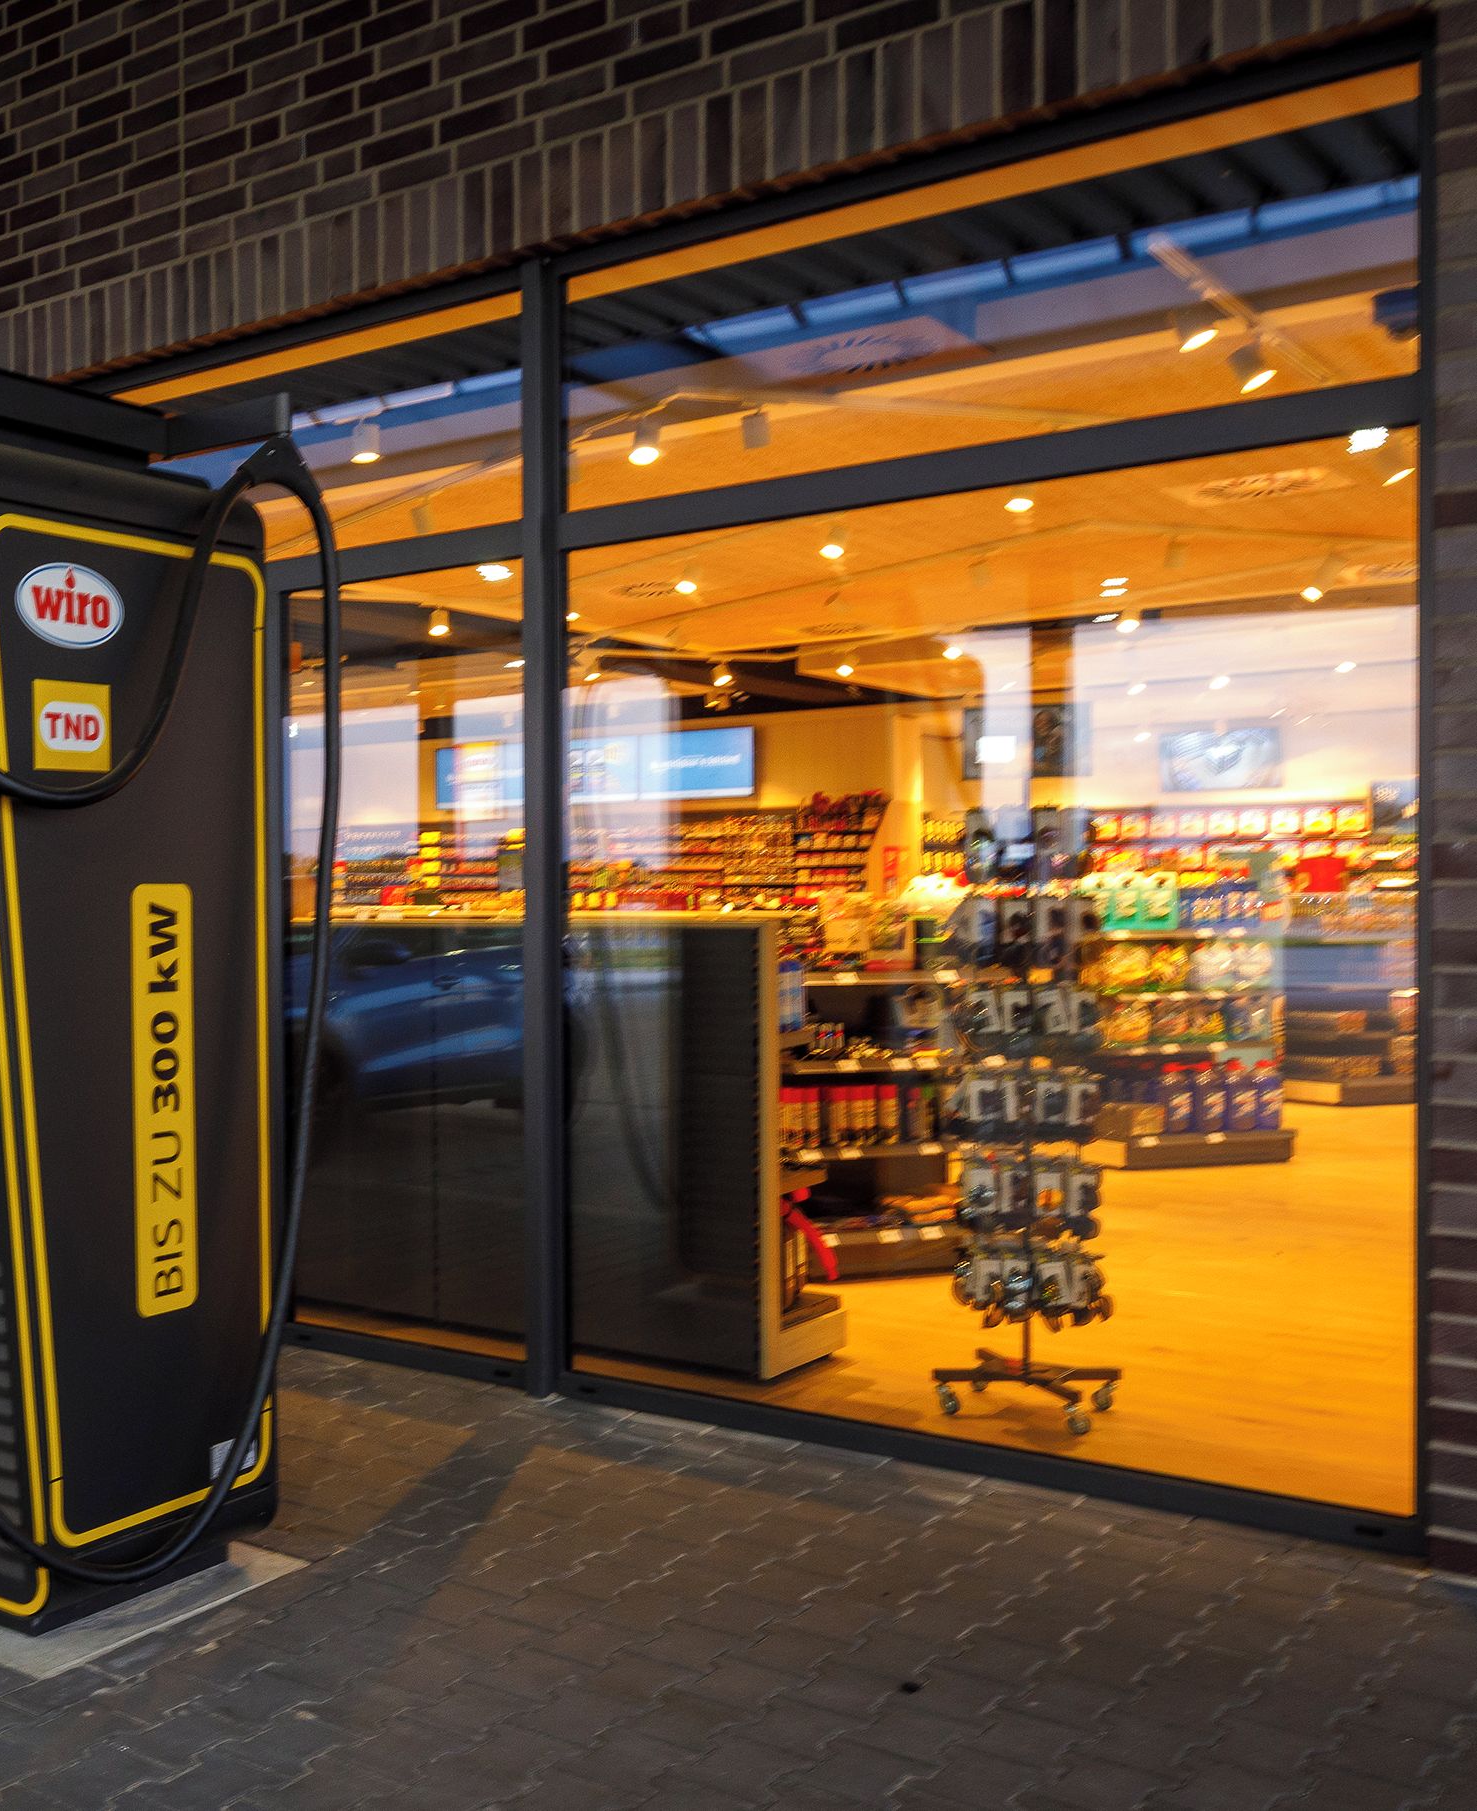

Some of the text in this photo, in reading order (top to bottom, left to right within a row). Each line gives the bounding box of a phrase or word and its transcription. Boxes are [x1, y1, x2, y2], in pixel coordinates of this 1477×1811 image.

[31, 567, 112, 629] wiro
[44, 711, 101, 741] TND
[148, 902, 184, 1298] BIS ZU 300 kW
